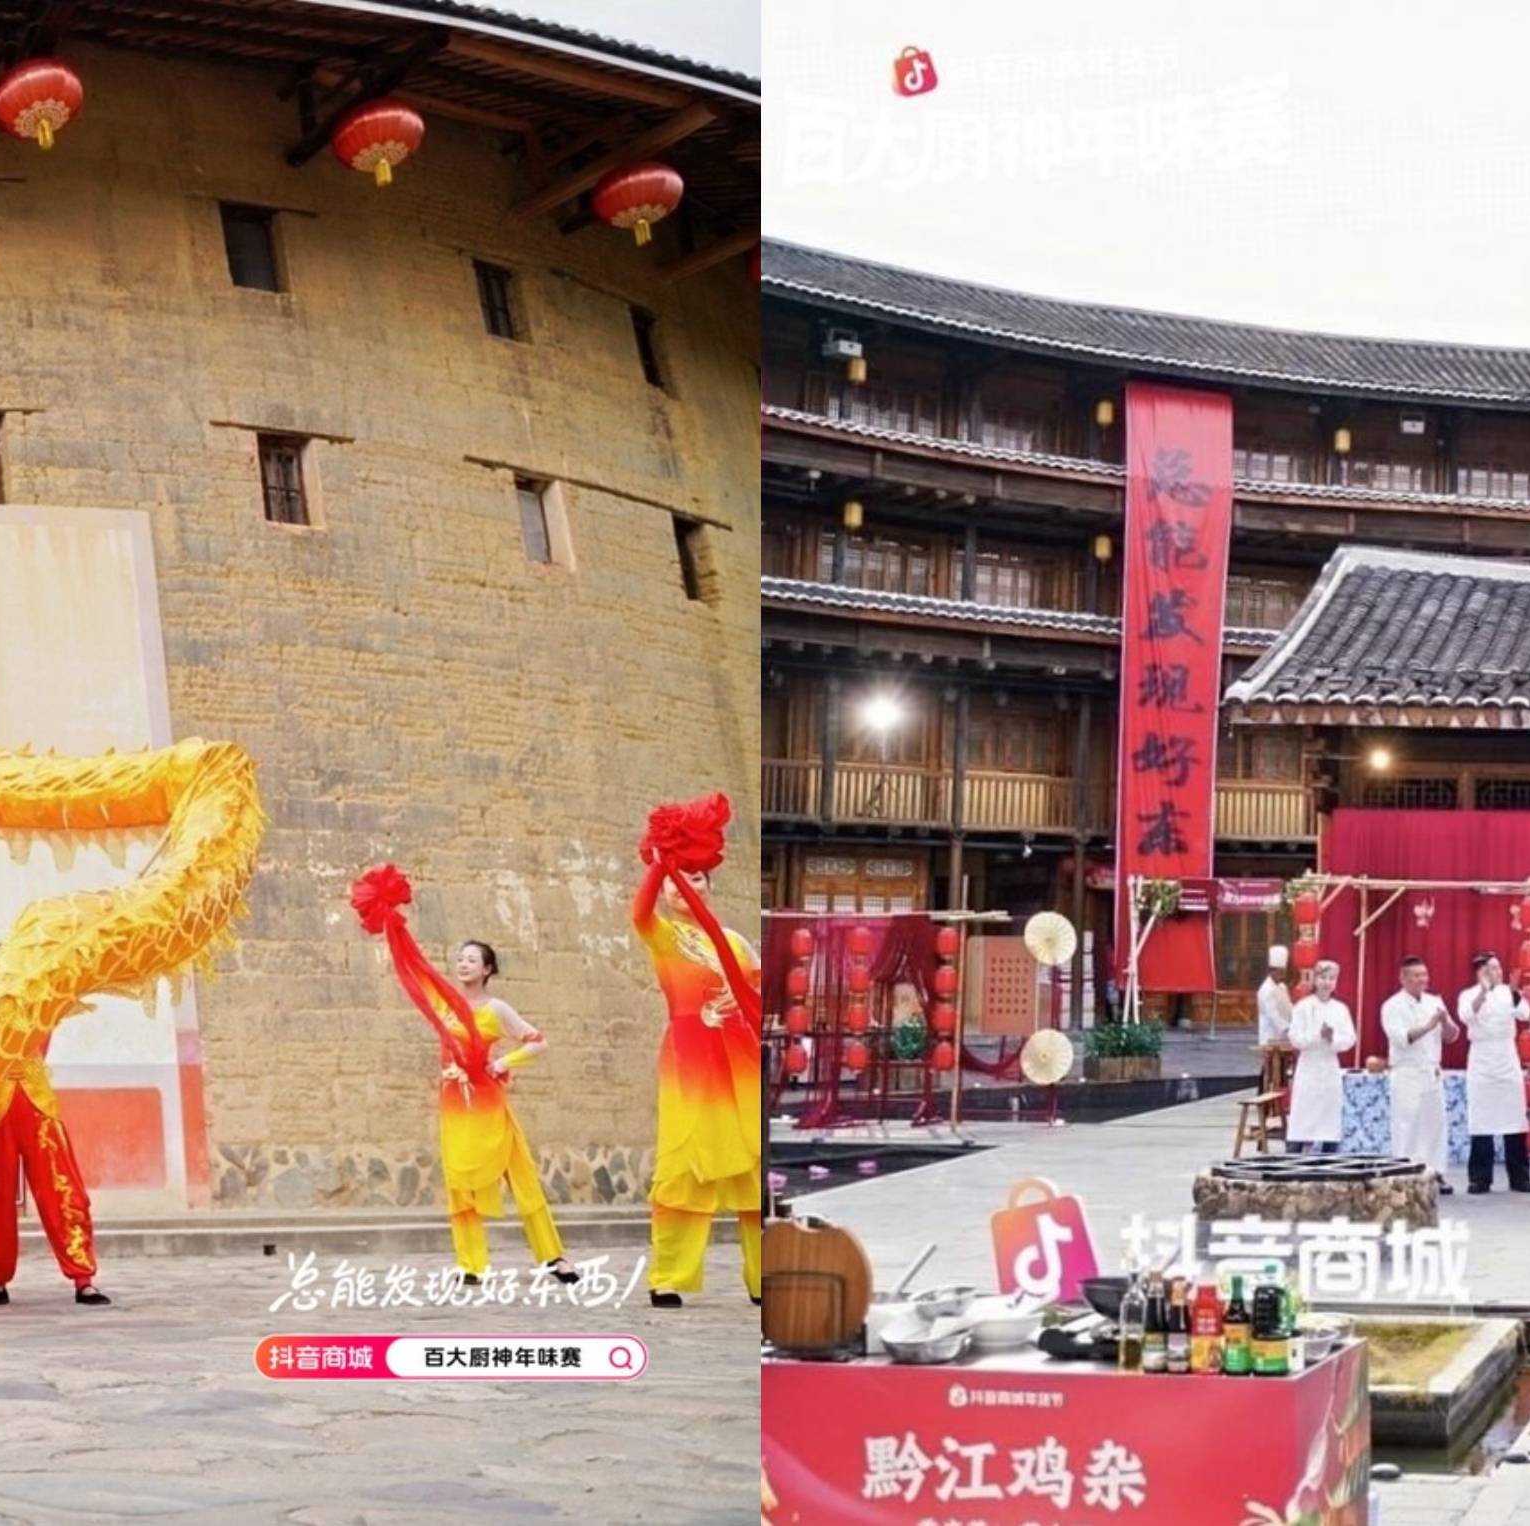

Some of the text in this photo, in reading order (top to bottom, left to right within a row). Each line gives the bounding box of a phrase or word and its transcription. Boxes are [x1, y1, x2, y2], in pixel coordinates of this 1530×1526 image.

[1119, 1213, 1470, 1303] 抖音商城
[861, 1431, 1148, 1512] 黔江鸡杂
